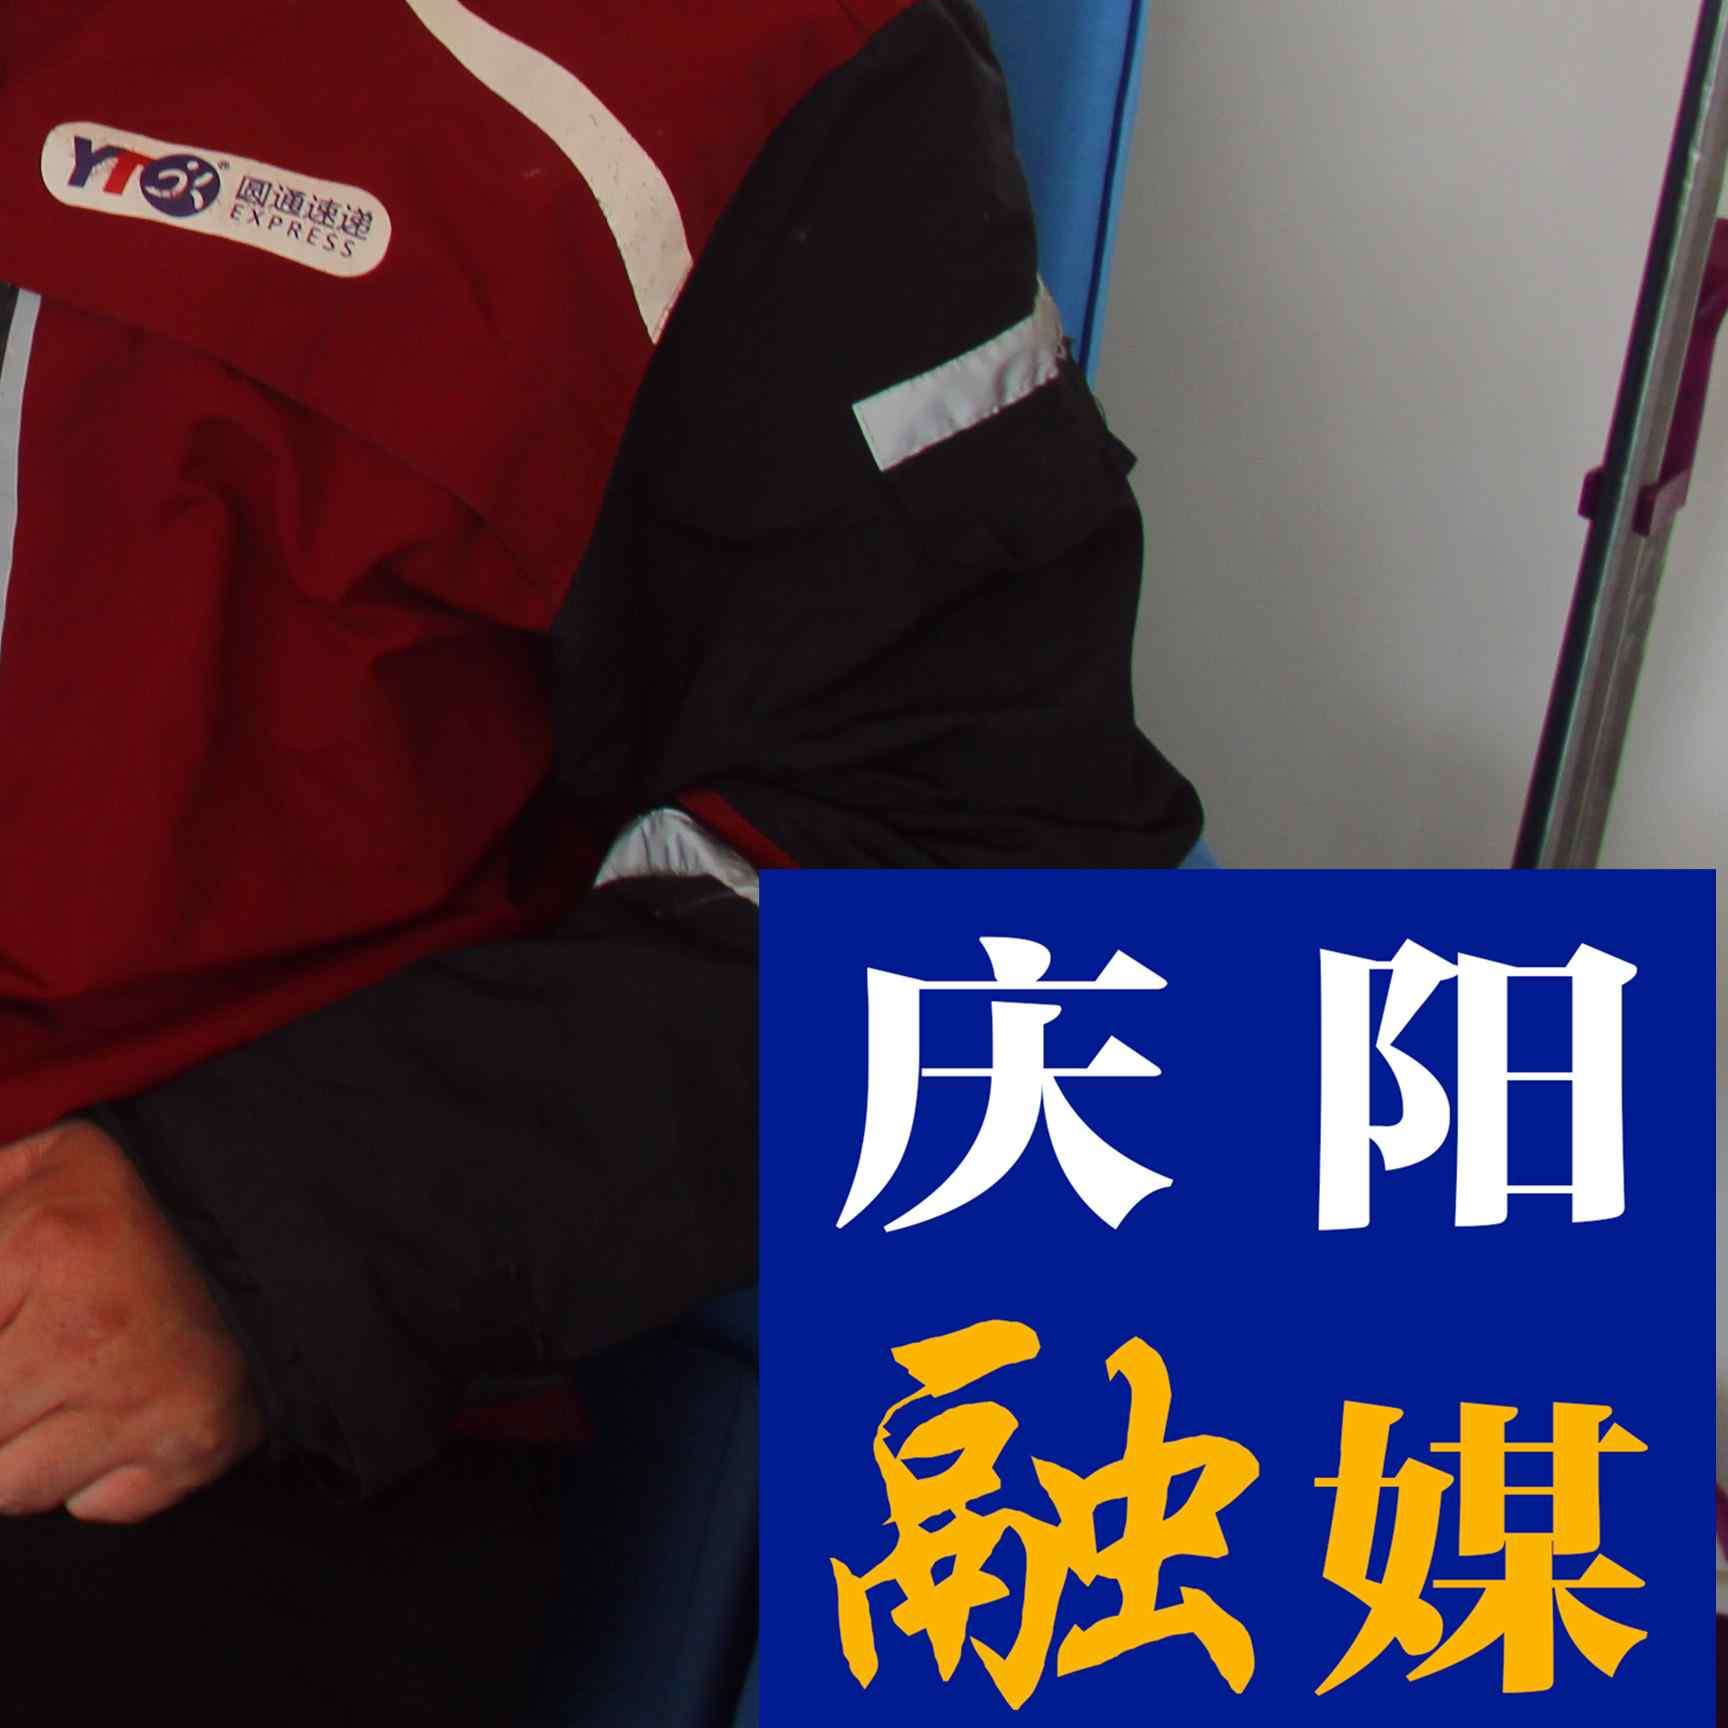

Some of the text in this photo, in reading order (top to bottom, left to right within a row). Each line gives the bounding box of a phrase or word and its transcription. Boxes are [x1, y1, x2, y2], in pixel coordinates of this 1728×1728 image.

[229, 202, 356, 258] EXPRESS
[235, 175, 374, 241] 圆通速递
